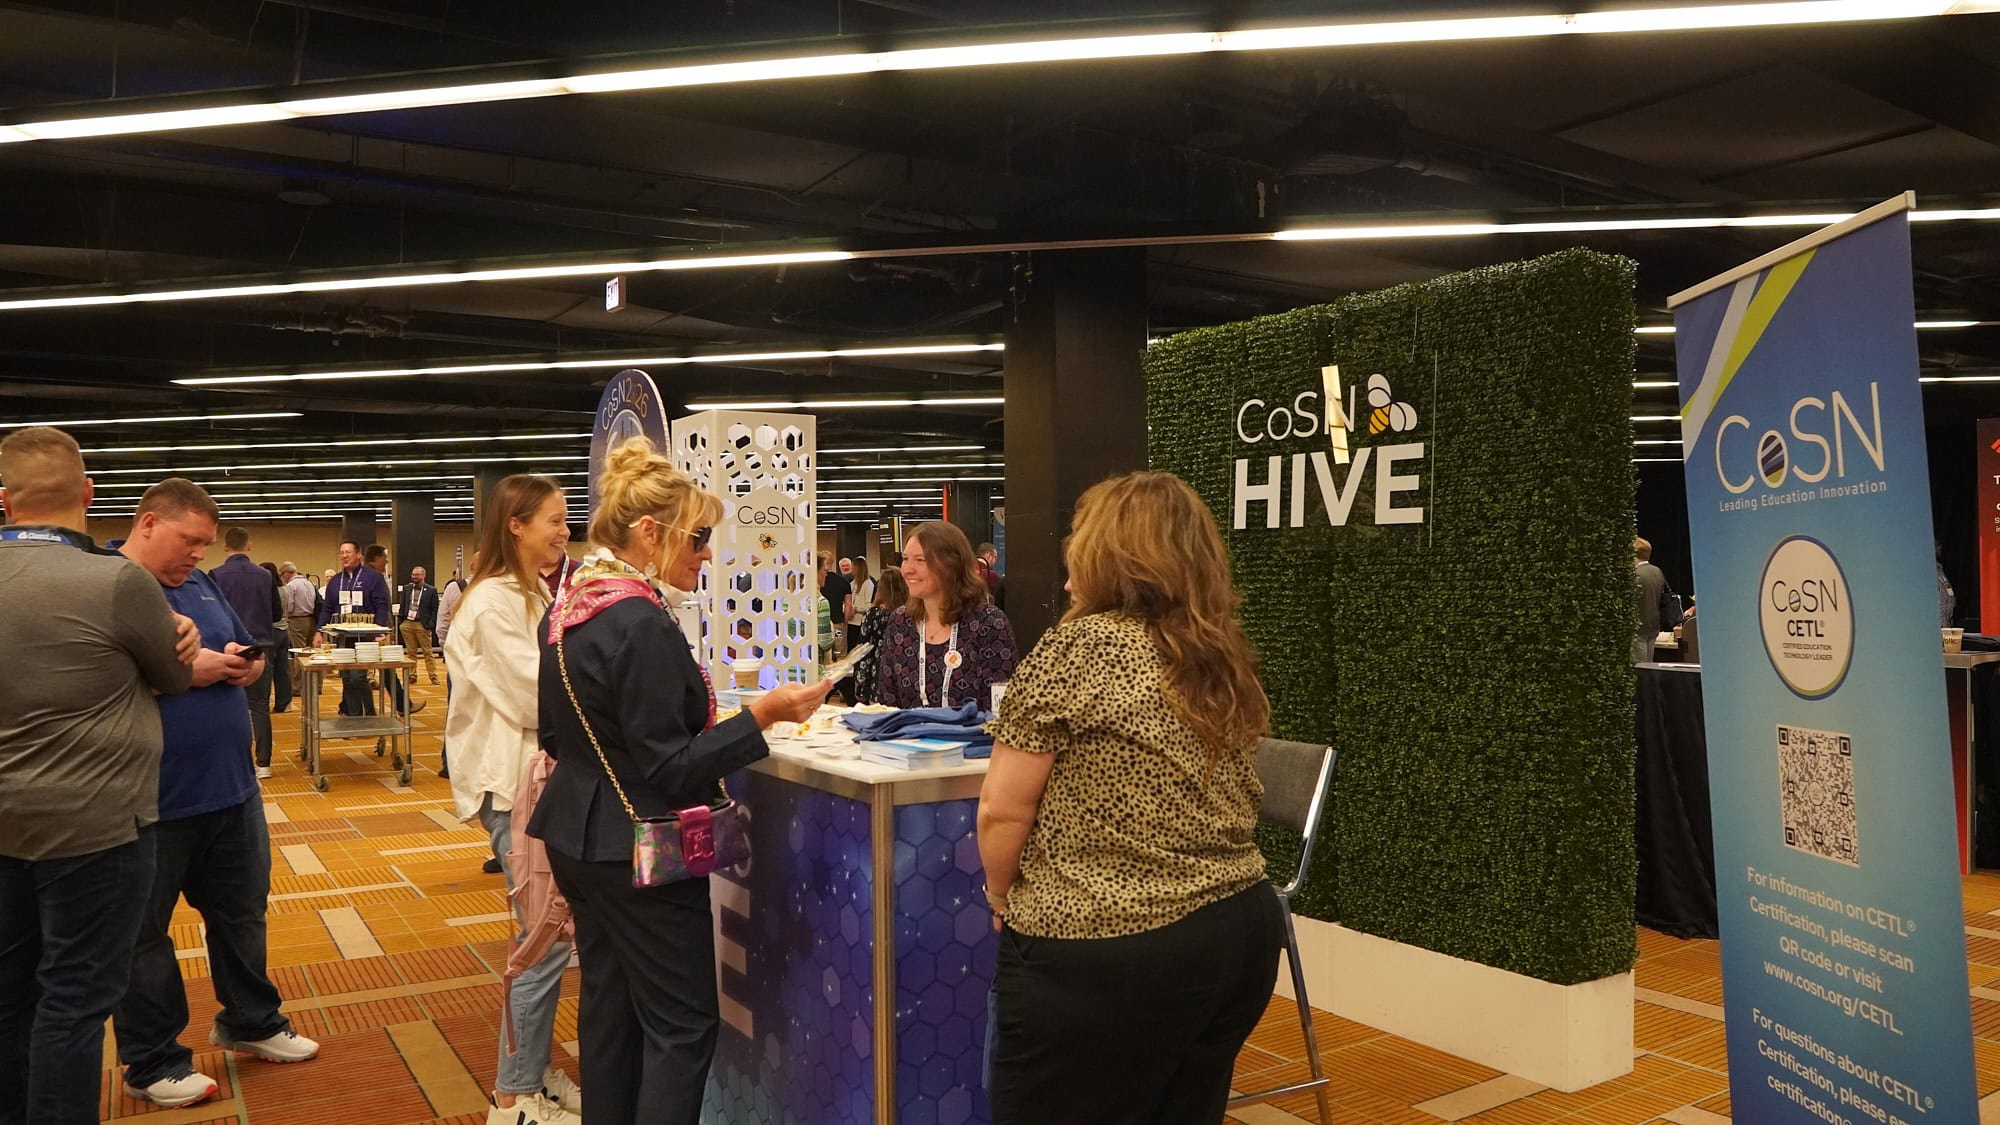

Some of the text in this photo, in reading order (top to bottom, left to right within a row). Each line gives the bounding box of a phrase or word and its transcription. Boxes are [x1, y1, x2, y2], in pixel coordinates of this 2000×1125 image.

[1237, 385, 1356, 443] CoSN
[1715, 381, 1884, 494] CoSN
[737, 505, 795, 525] CoSN
[1233, 442, 1425, 529] HIVE
[1719, 480, 1887, 512] Leading Education Innovation
[1772, 579, 1838, 613] CoSN
[1746, 866, 1767, 884] For
[1769, 873, 1844, 915] information
[1846, 904, 1865, 922] on
[1750, 895, 1915, 974] Certification, please scan
[1779, 935, 1884, 994] QR code or visit
[1752, 1007, 1774, 1031] For
[1775, 1023, 1836, 1065] questions
[1837, 1055, 1881, 1089] about
[1758, 1039, 1888, 1124] Certification, please
